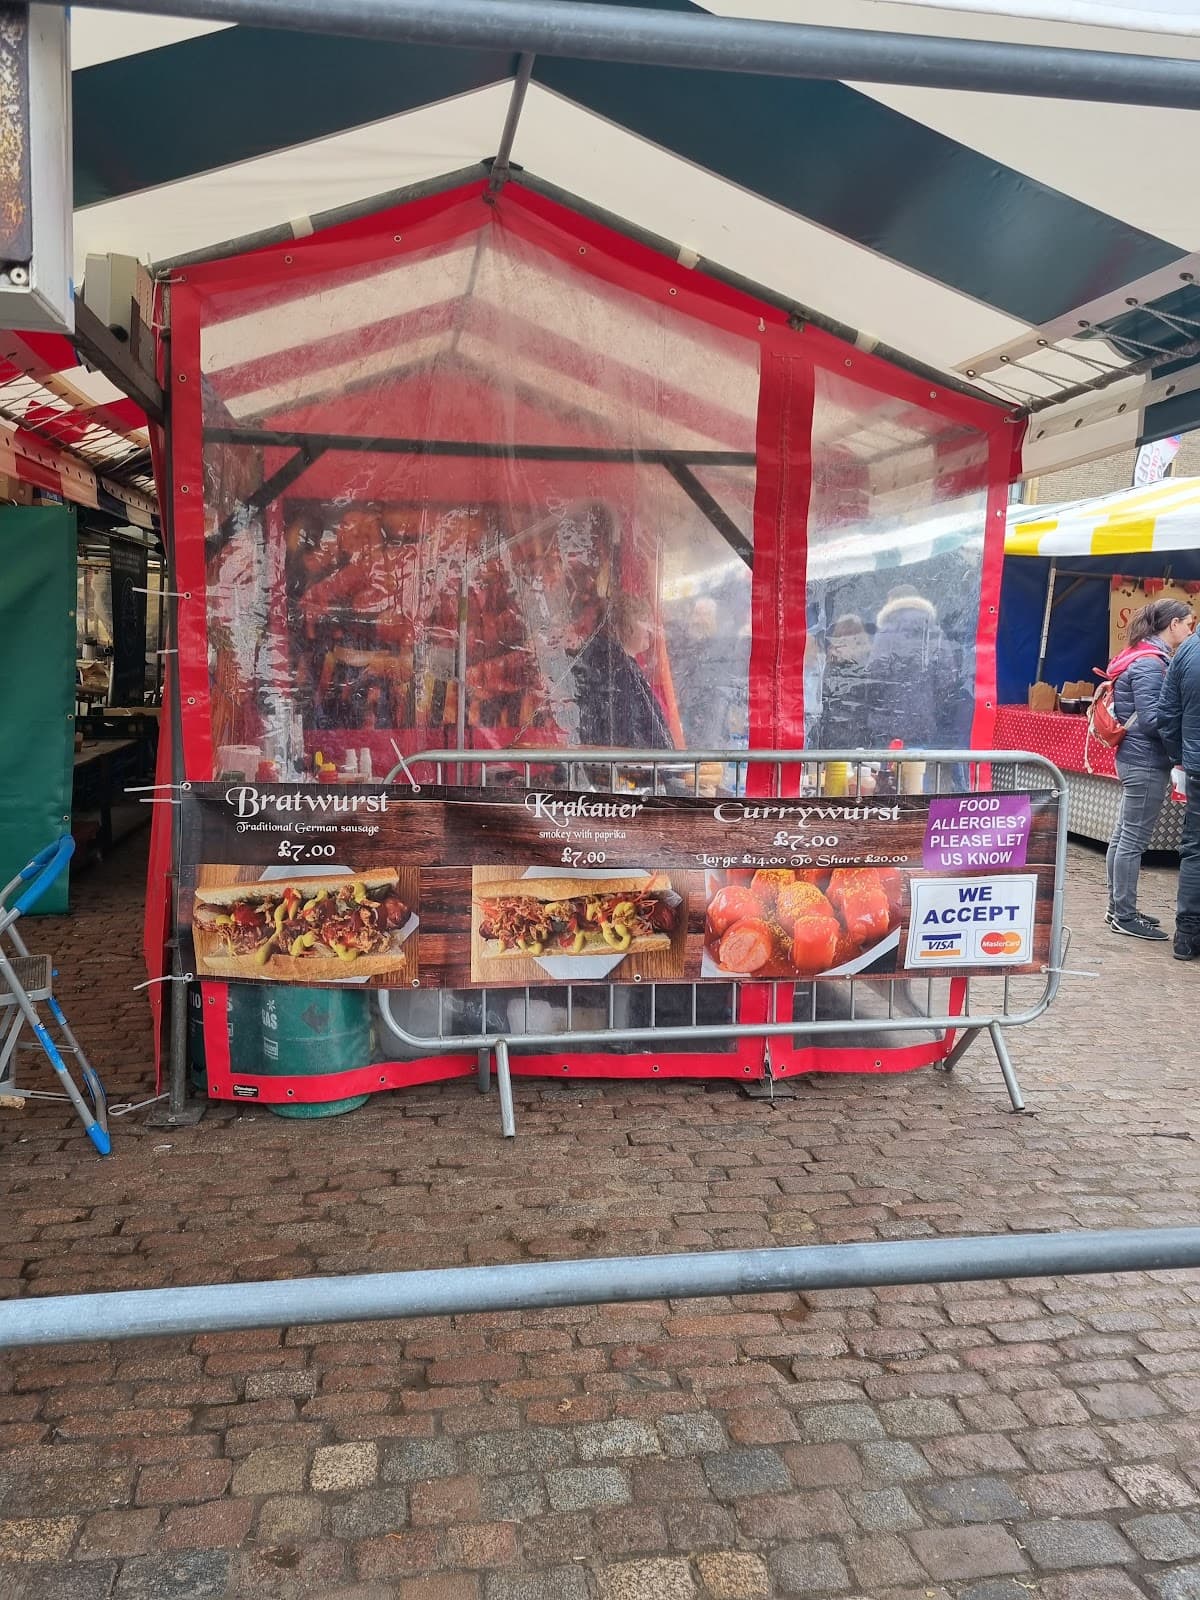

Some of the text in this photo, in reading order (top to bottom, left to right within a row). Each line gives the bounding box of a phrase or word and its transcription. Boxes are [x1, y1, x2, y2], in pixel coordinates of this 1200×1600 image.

[226, 786, 389, 818] Bratwurst
[525, 792, 643, 828] Krakauer
[958, 799, 1000, 813] FOOD
[713, 802, 901, 828] Currywurst
[931, 815, 1027, 831] ALLERGIES?
[236, 821, 380, 837] Traditional German sausage
[539, 828, 626, 843] smokey with paprika
[773, 830, 839, 850] £7.00
[930, 833, 1025, 848] PLEASE LET
[277, 840, 336, 862] £7.00
[560, 846, 606, 868] £7.00
[940, 851, 1013, 866] US KNOW
[695, 853, 909, 868] Large £14.00 To Share £20.00
[958, 886, 993, 903] WE
[922, 905, 1020, 925] ACCEPT
[928, 940, 955, 950] VISA
[981, 939, 1021, 947] MasterCard
